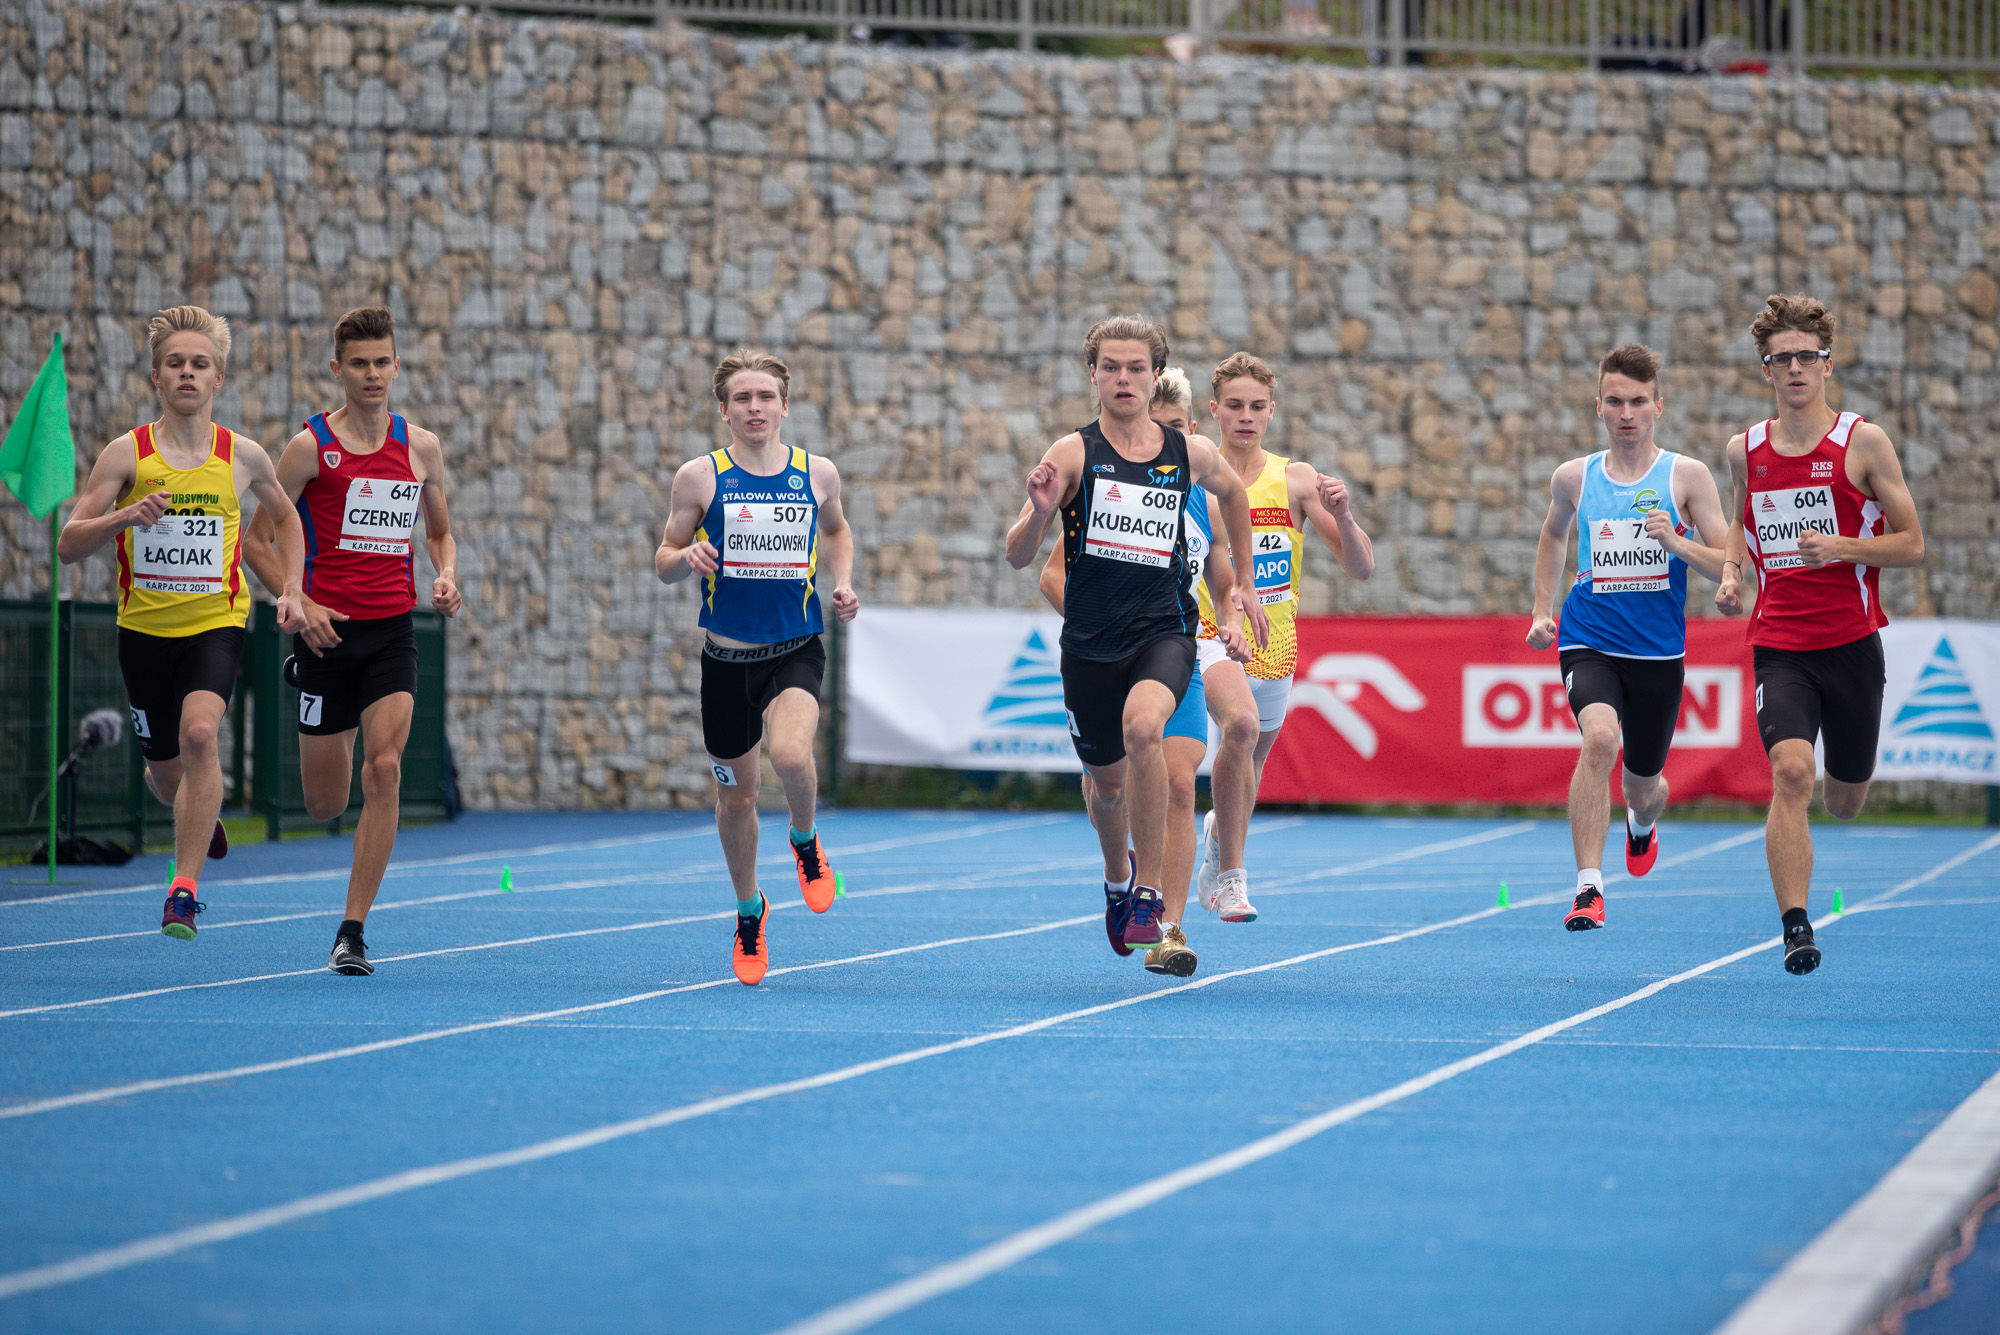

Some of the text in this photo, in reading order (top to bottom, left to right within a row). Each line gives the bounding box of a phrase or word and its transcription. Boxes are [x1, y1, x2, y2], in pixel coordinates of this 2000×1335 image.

[1091, 464, 1115, 473] esa
[1811, 461, 1833, 471] RKS
[145, 478, 165, 486] esa
[1147, 468, 1180, 489] Sopot
[171, 492, 219, 505] URSYNÓW
[390, 484, 419, 501] 647
[722, 492, 809, 502] STALOWA WOLA
[1141, 490, 1177, 511] 608
[1794, 490, 1828, 509] 604
[773, 506, 807, 522] 507
[1252, 516, 1287, 525] WROCŁAW
[1256, 509, 1270, 517] MKS
[183, 519, 218, 536] 321
[1092, 511, 1174, 540] KUBACKI
[352, 542, 391, 552] KARPACZ
[728, 533, 807, 551] GRYKAŁOWSKI
[1259, 534, 1282, 550] 42
[144, 546, 213, 566] ŁACIAK
[1097, 547, 1140, 562] KARPACZ
[1142, 556, 1160, 566] 2021
[1593, 546, 1667, 567] KAMIŃSKI
[736, 568, 799, 578] KARPACZ 2021
[1254, 559, 1289, 580] APO
[146, 581, 210, 592] KARPACZ 2021
[1601, 581, 1661, 592] KARPACZ 2021
[1265, 594, 1282, 604] 2021
[731, 648, 769, 660] PRO
[303, 695, 316, 722] 7
[1482, 681, 1721, 733] ORN
[971, 739, 1076, 756] KARPAC
[1882, 747, 1996, 772] KARPACZ
[713, 765, 730, 784] 6
